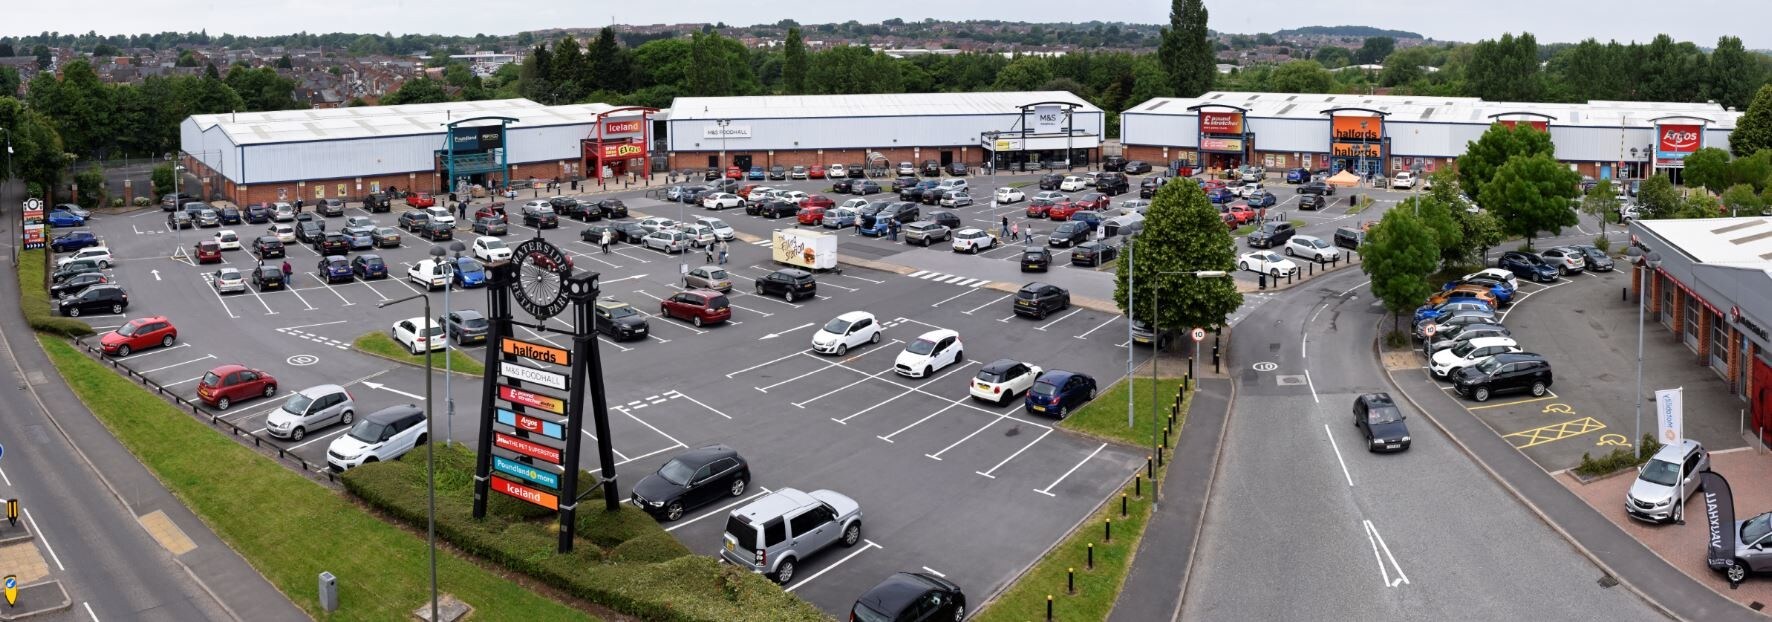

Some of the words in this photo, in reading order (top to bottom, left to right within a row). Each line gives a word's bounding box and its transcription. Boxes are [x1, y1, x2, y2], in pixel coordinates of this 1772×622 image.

[609, 122, 639, 132] Iceland
[1040, 114, 1056, 122] M&S
[1336, 129, 1377, 138] halfords
[1663, 130, 1697, 143] Argos
[511, 241, 567, 273] WATERSIDE
[511, 282, 542, 316] RETAIL
[548, 289, 569, 315] PARK
[513, 343, 557, 363] halfords
[505, 365, 520, 376] M&S
[521, 369, 561, 385] FOODHALL
[521, 417, 538, 427] Argos
[509, 440, 519, 448] THE
[518, 442, 528, 450] PET
[528, 445, 560, 460] SUPERSTORE
[496, 460, 530, 477] Poundland
[537, 474, 555, 484] more
[507, 483, 541, 502] Iceland
